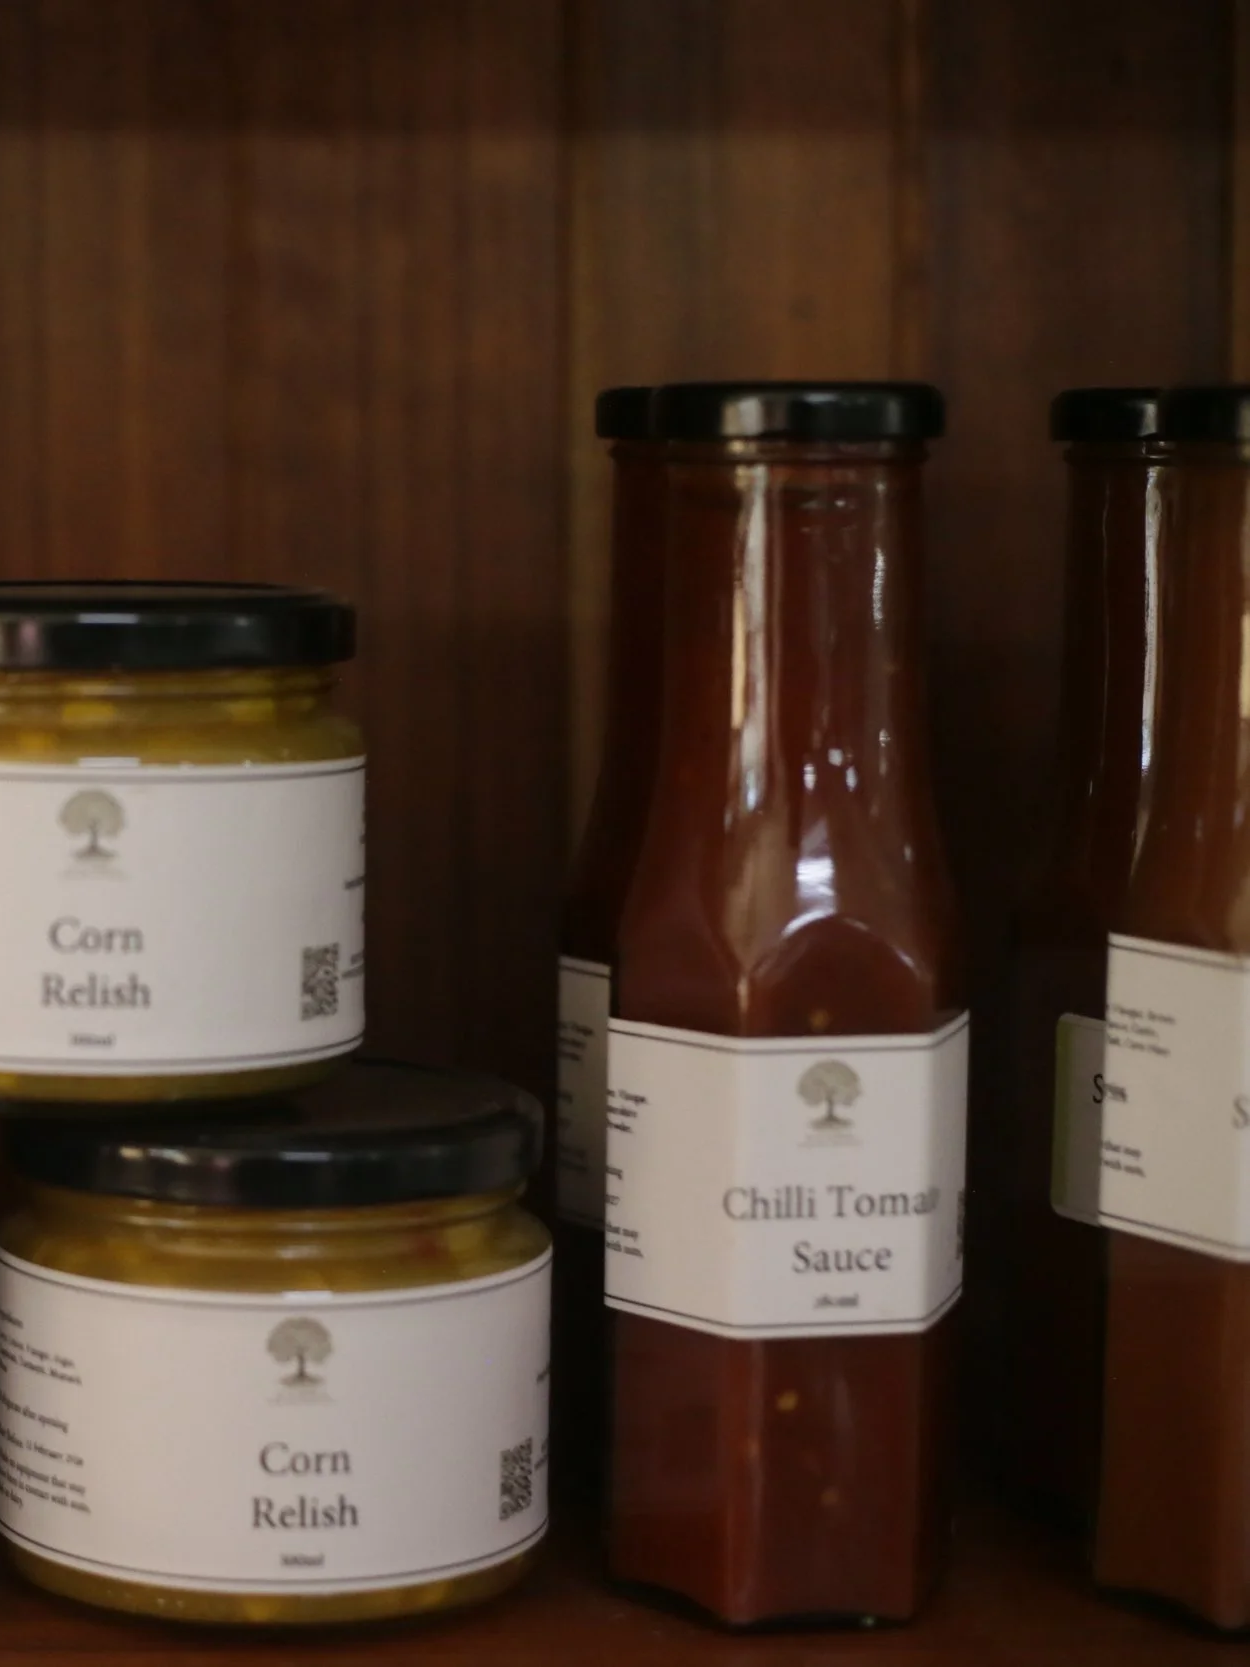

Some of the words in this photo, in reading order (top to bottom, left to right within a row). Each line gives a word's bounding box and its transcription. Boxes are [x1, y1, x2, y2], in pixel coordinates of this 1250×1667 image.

[47, 915, 144, 955] Corn
[40, 971, 152, 1010] Relish
[721, 1186, 818, 1221] Chilli
[792, 1240, 893, 1274] Sauce
[258, 1440, 352, 1477] Corn
[252, 1494, 359, 1530] Relish
